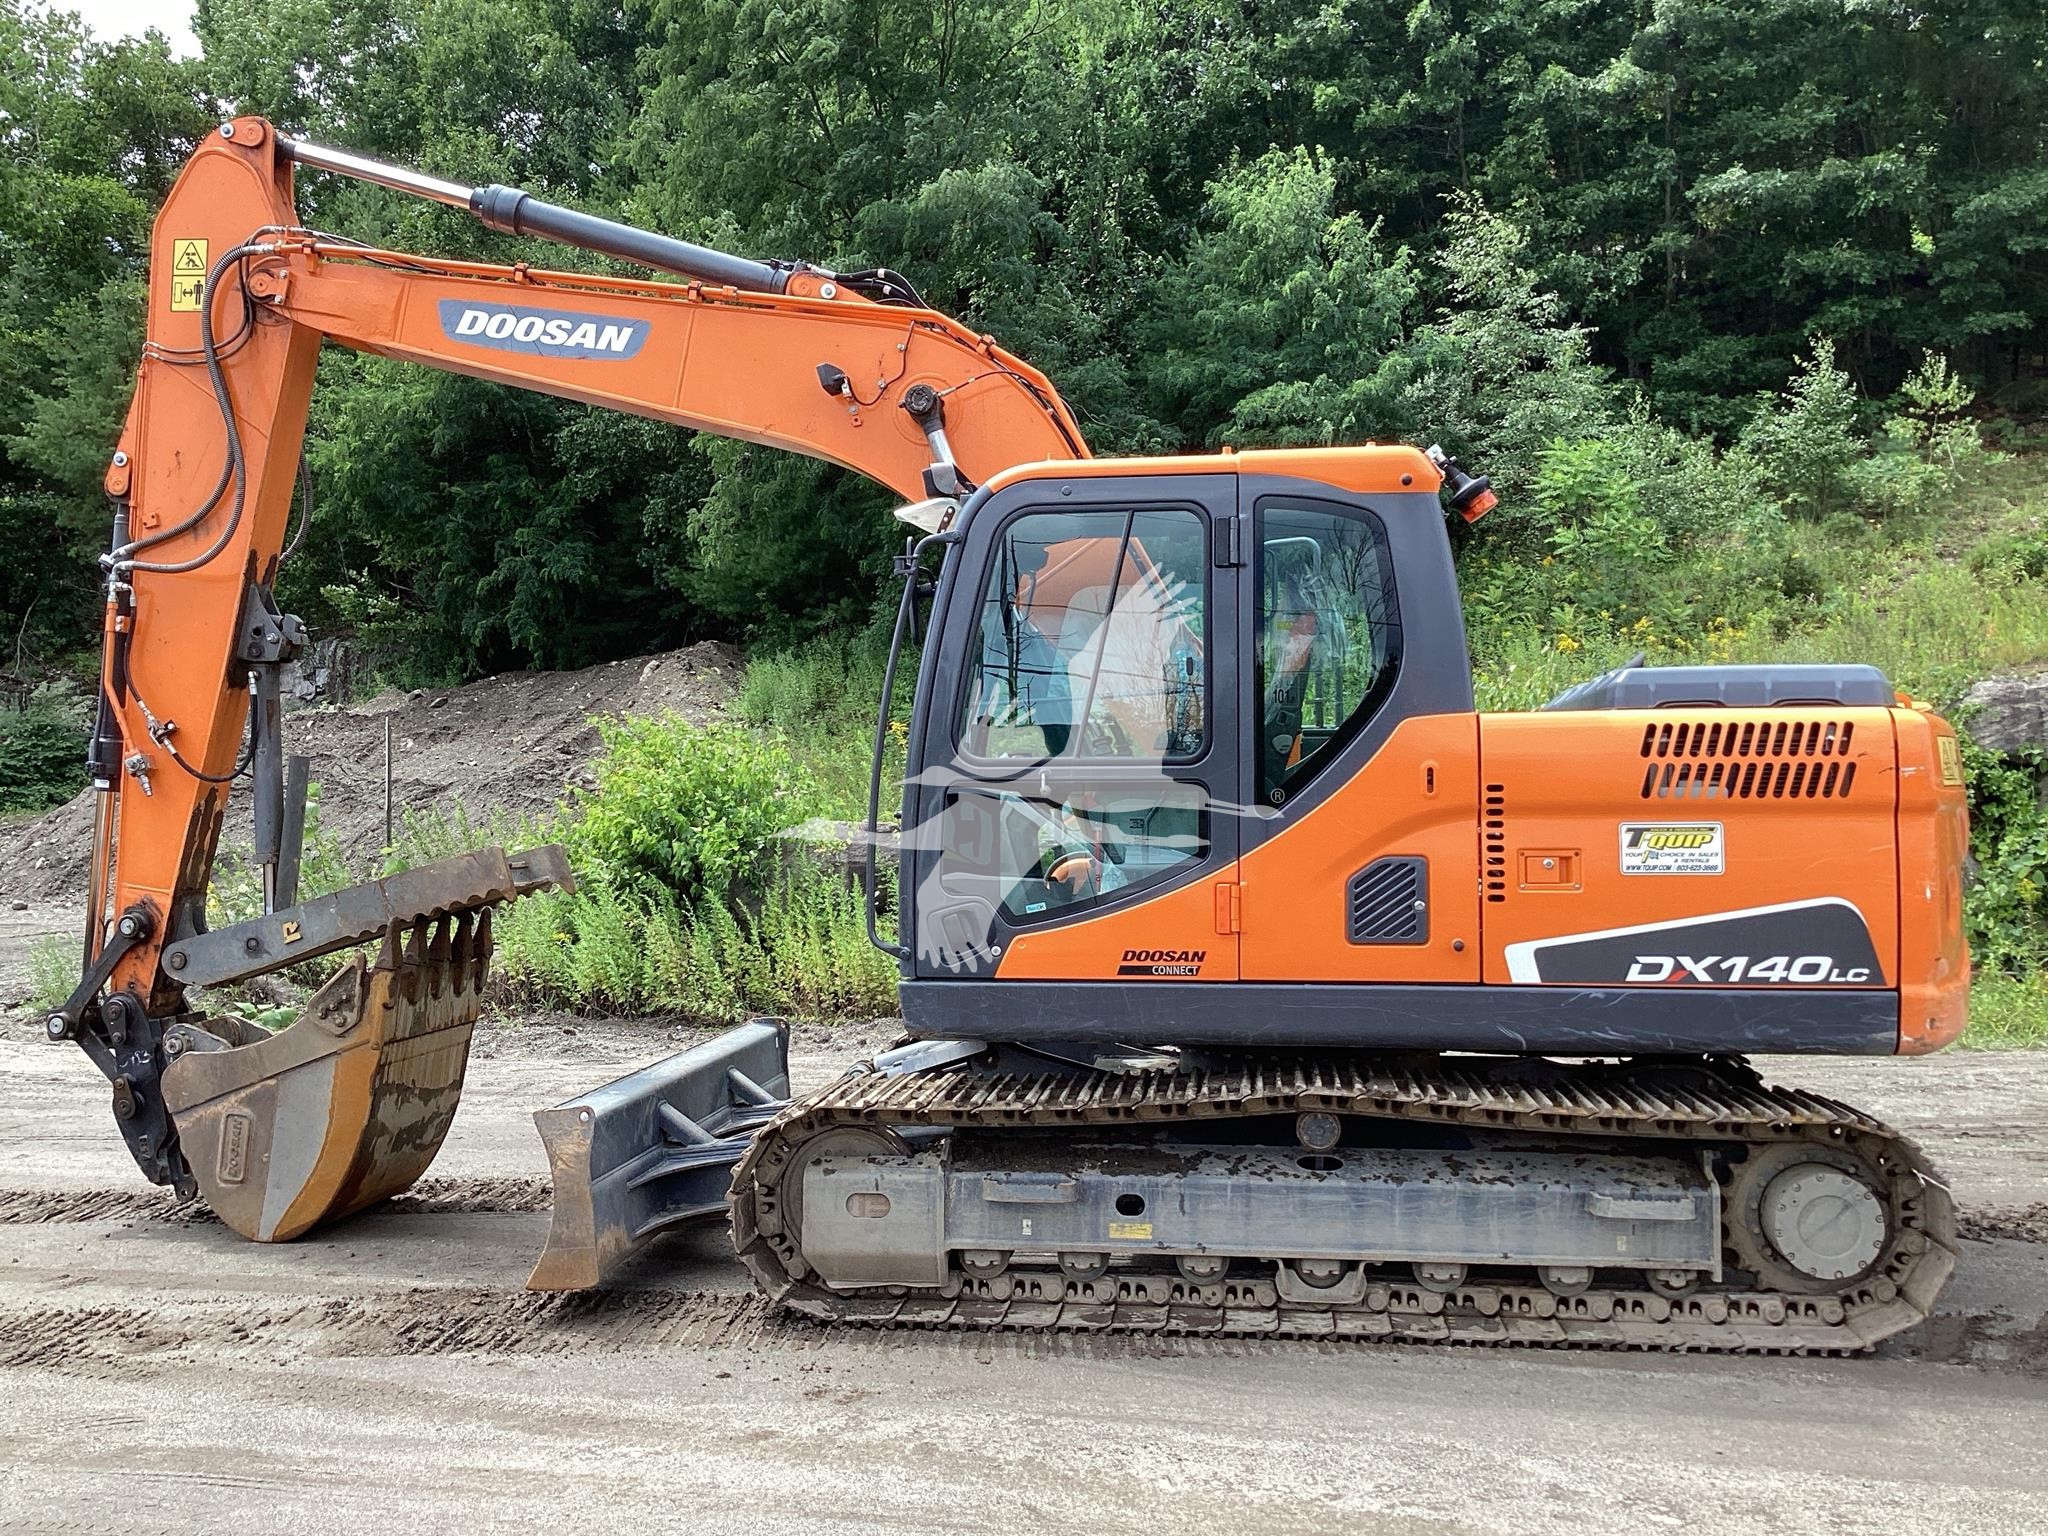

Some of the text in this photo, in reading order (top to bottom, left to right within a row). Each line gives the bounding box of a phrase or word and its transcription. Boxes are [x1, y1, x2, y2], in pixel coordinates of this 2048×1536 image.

[454, 309, 634, 352] DOOSAN
[1121, 950, 1206, 962] DOOSAN
[1152, 966, 1198, 975] CONNECT
